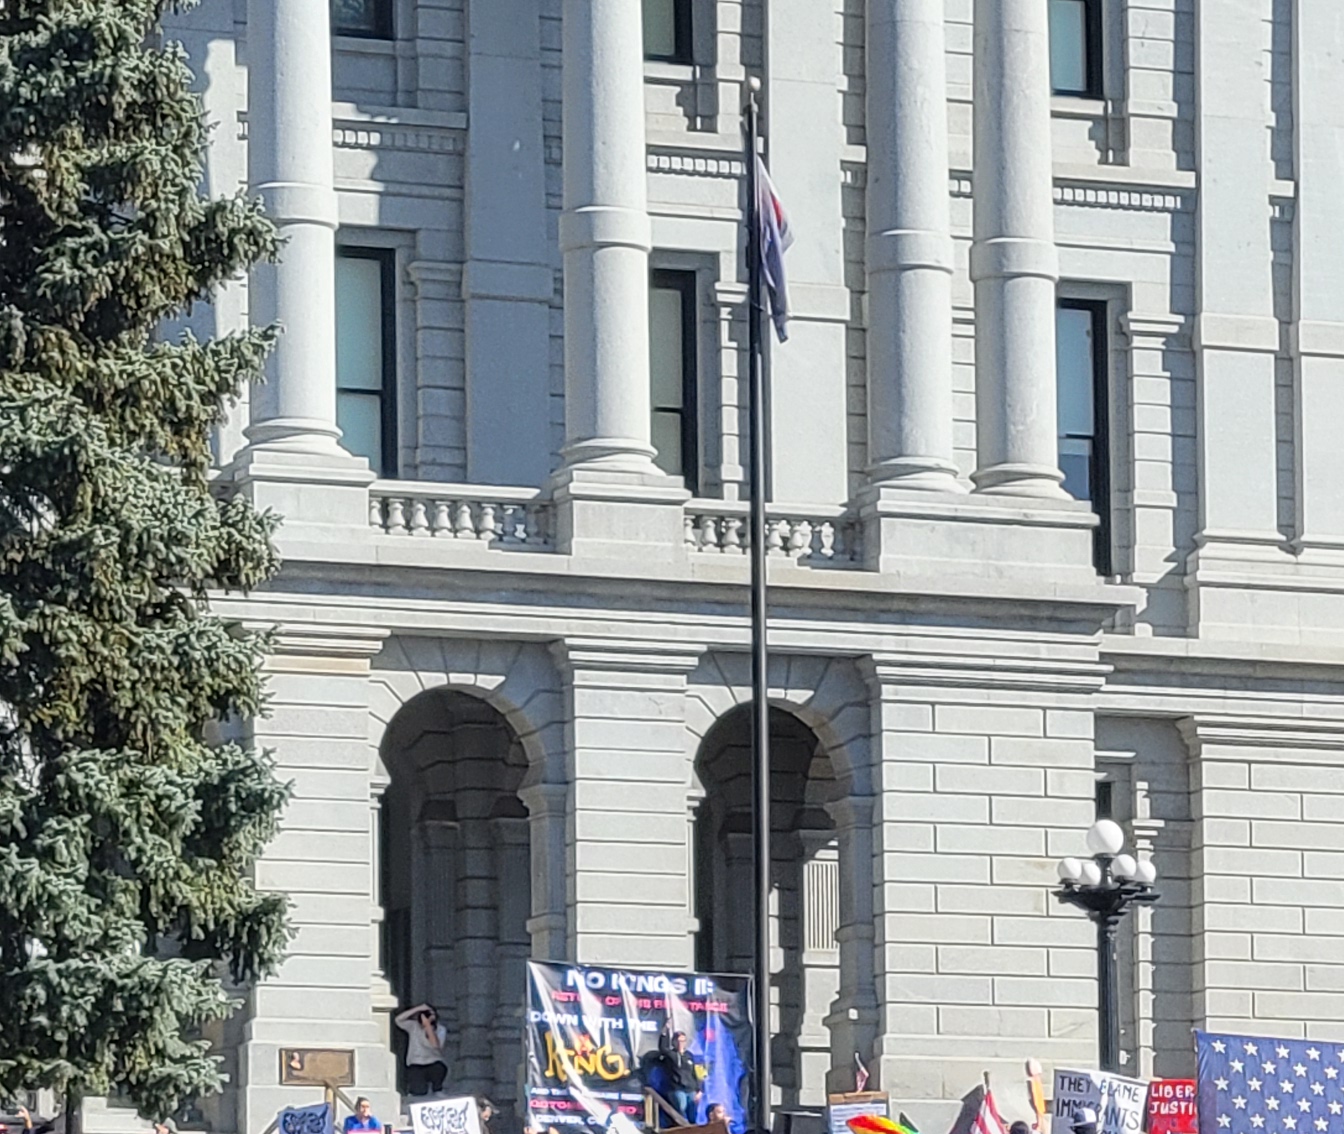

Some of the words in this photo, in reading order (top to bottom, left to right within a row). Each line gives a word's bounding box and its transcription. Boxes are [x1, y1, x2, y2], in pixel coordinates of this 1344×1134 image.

[566, 969, 604, 989] NO
[611, 972, 687, 995] KINGS
[530, 1011, 578, 1026] DOWN
[1059, 1075, 1092, 1093] THEY
[1099, 1078, 1140, 1104] BLAME
[1150, 1101, 1198, 1116] JUSTI
